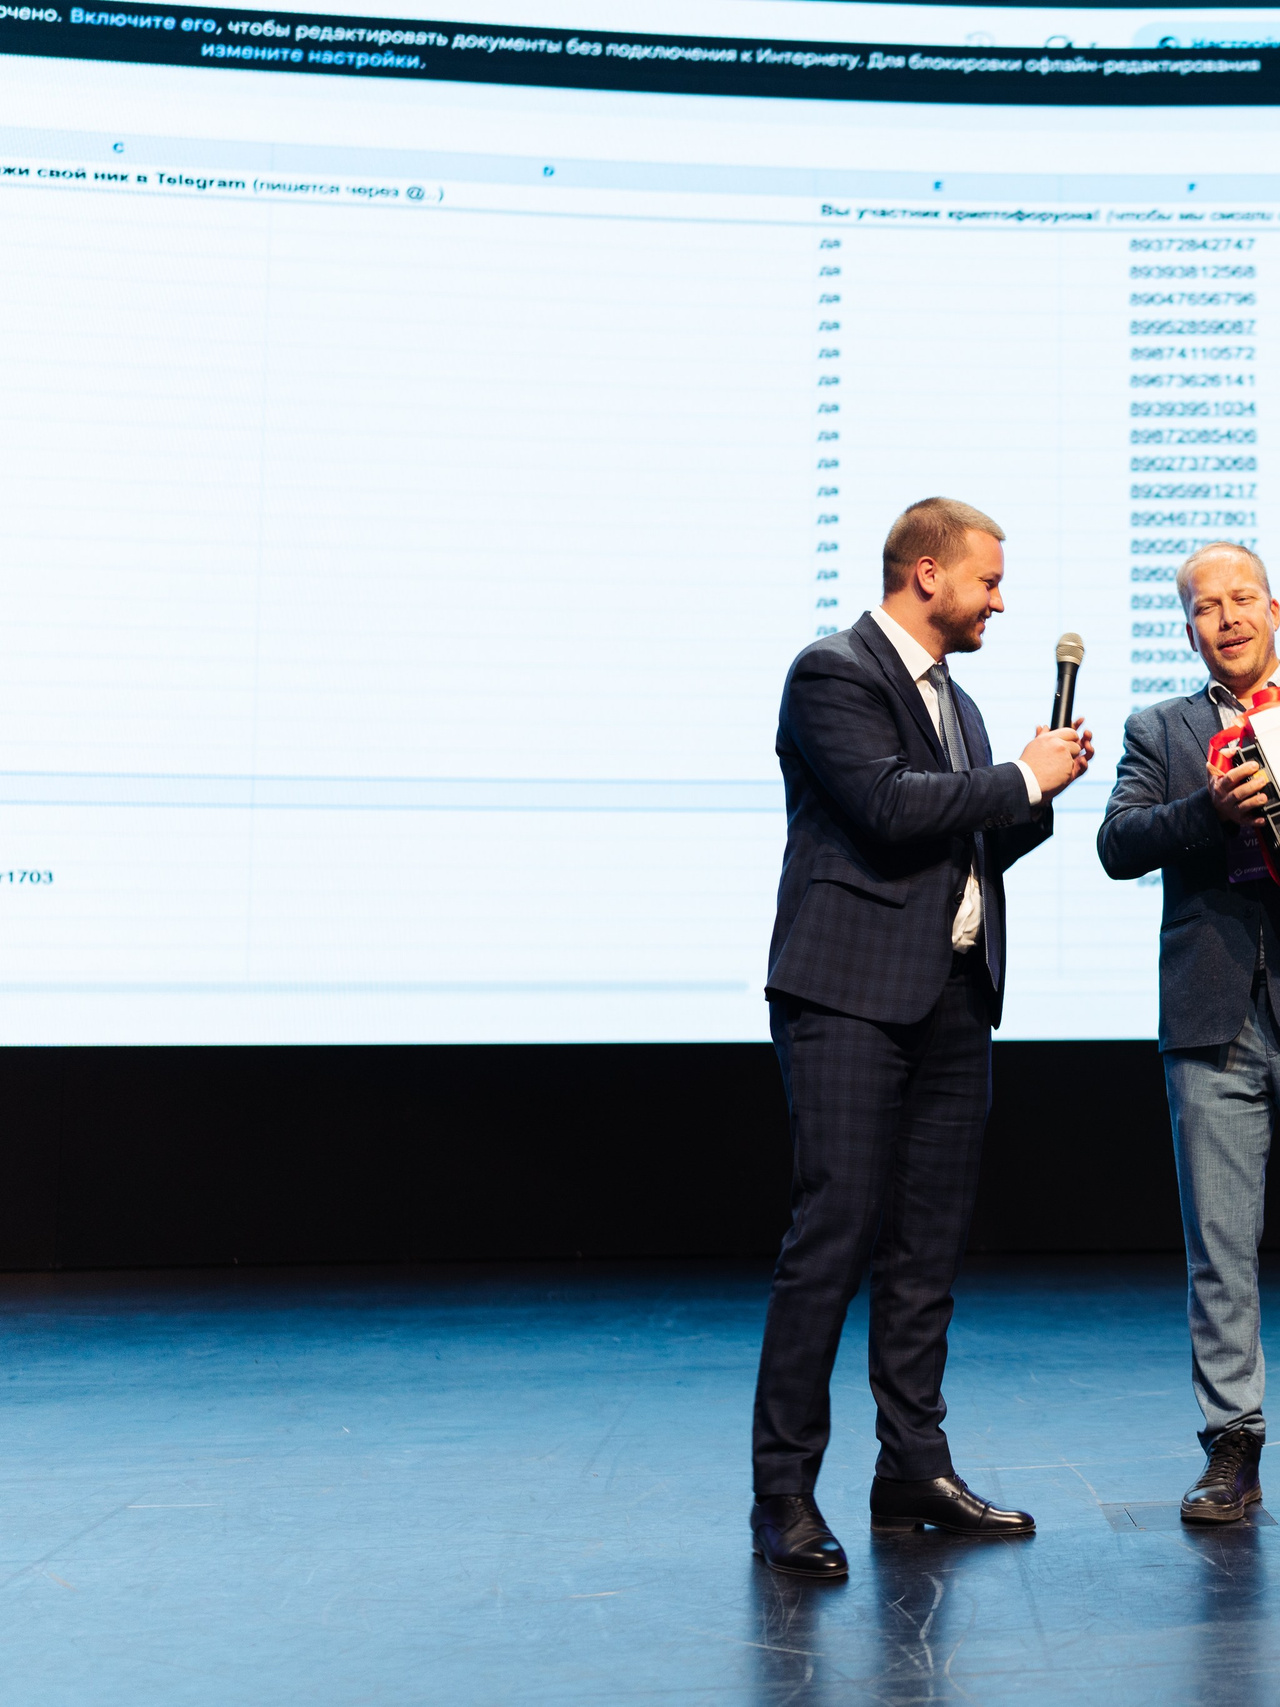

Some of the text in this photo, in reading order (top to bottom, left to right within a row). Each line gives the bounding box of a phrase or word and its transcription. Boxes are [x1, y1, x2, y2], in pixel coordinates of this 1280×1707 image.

[69, 6, 177, 31] Включите
[226, 19, 290, 38] чтобы
[295, 24, 449, 47] редактировать
[451, 33, 562, 54] документы
[565, 38, 603, 56] без
[605, 42, 738, 61] подключения
[866, 52, 906, 70] Для
[200, 43, 304, 64] измените
[0, 167, 30, 176] жи
[157, 173, 246, 190] Telegram
[1130, 238, 1255, 251] 89372842747
